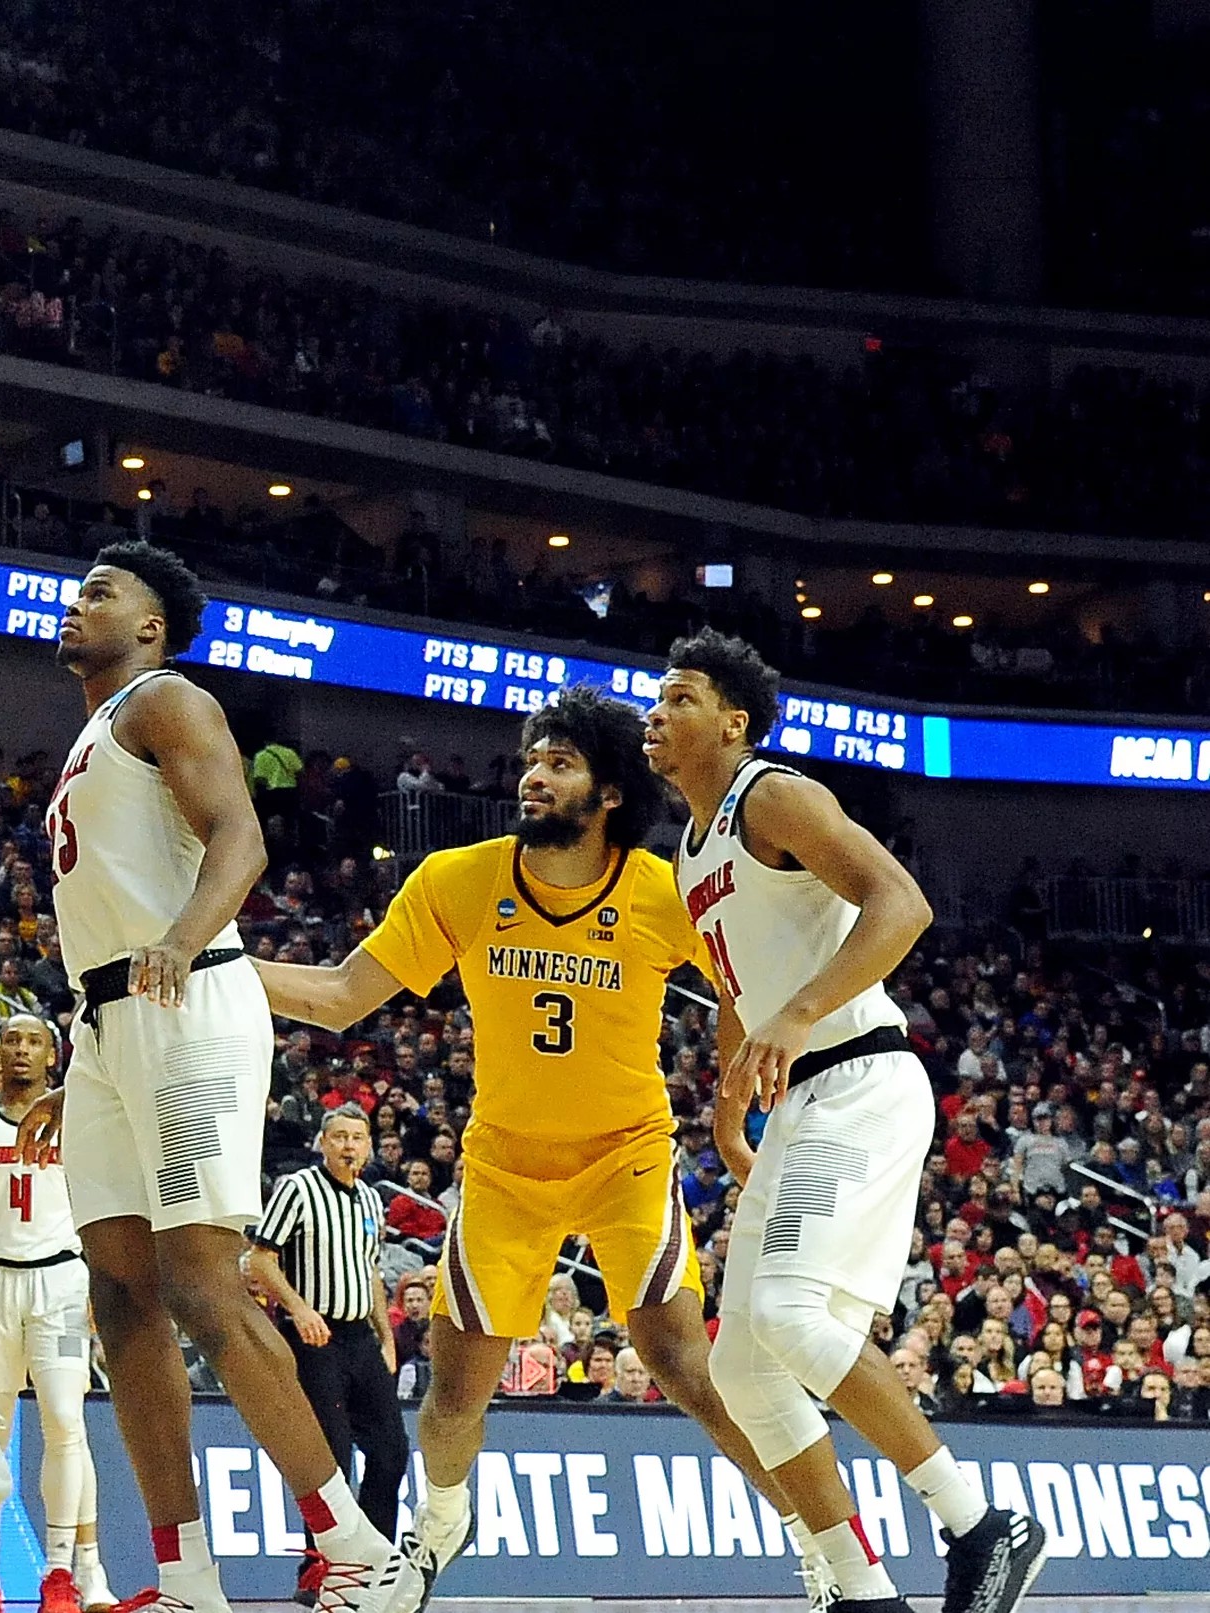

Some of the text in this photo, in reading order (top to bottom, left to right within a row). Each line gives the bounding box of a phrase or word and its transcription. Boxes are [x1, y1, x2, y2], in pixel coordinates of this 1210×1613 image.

[8, 572, 57, 602] PTS
[7, 609, 57, 639] PTS
[224, 607, 243, 631] 3
[208, 641, 243, 667] 25
[425, 639, 468, 667] PTS
[505, 652, 542, 679] FLS
[425, 673, 468, 702] PTS
[470, 679, 486, 705] 7
[505, 686, 543, 713] FLS
[612, 669, 628, 693] 5
[786, 699, 824, 725] PTS
[856, 710, 889, 736] FLS
[892, 715, 906, 740] 1
[835, 735, 873, 762] FT%
[487, 945, 623, 992] MINNESOTA
[532, 990, 575, 1056] 3
[9, 1172, 33, 1223] 4
